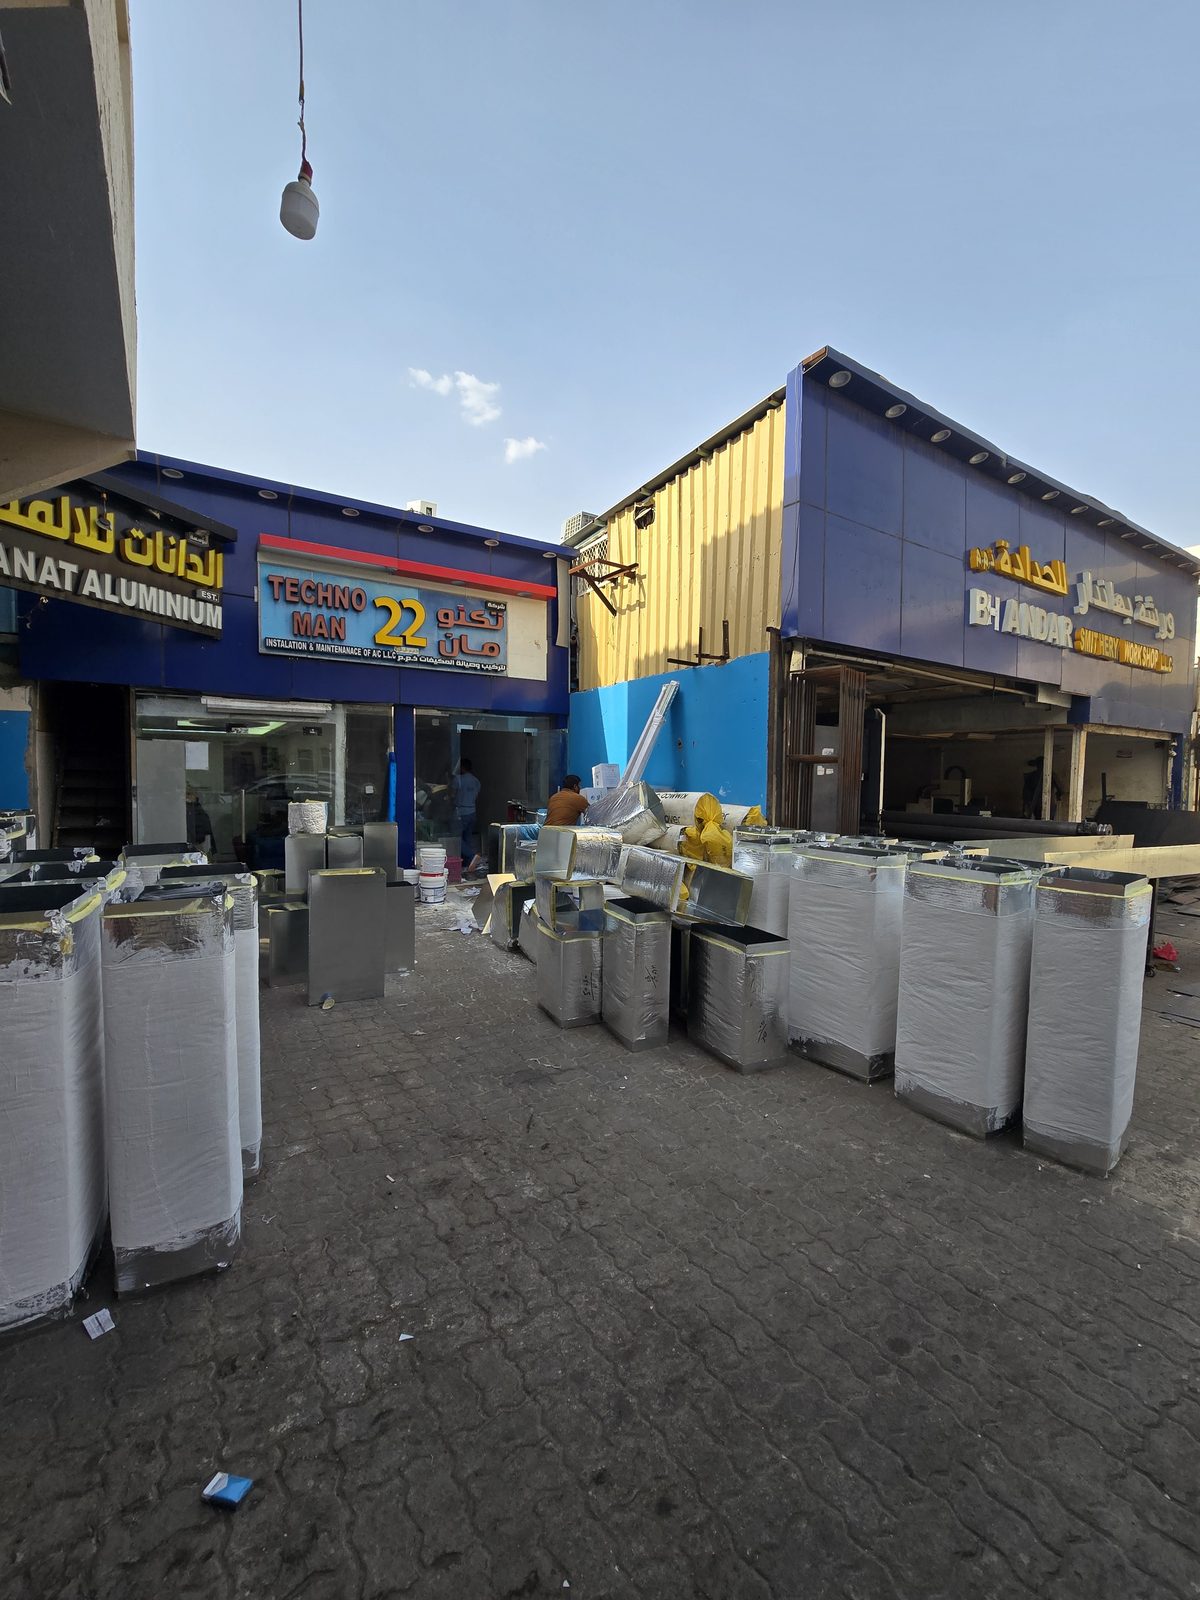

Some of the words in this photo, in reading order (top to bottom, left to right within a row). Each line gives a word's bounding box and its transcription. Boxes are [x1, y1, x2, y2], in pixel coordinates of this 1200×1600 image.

[123, 528, 223, 588] الدانات
[995, 540, 1068, 595] الحدادة
[83, 568, 222, 630] ALUMINIUM
[268, 575, 367, 612] TECHNO
[293, 611, 345, 640] MAN
[373, 596, 427, 647] 22
[436, 604, 504, 630] تكنو
[1134, 595, 1174, 639] ورشة
[265, 638, 307, 650] INSTALATION
[308, 643, 314, 651] &
[363, 648, 371, 657] OF
[419, 655, 455, 666] المكيفات
[438, 633, 500, 657] مان
[456, 660, 480, 670] وصيانة
